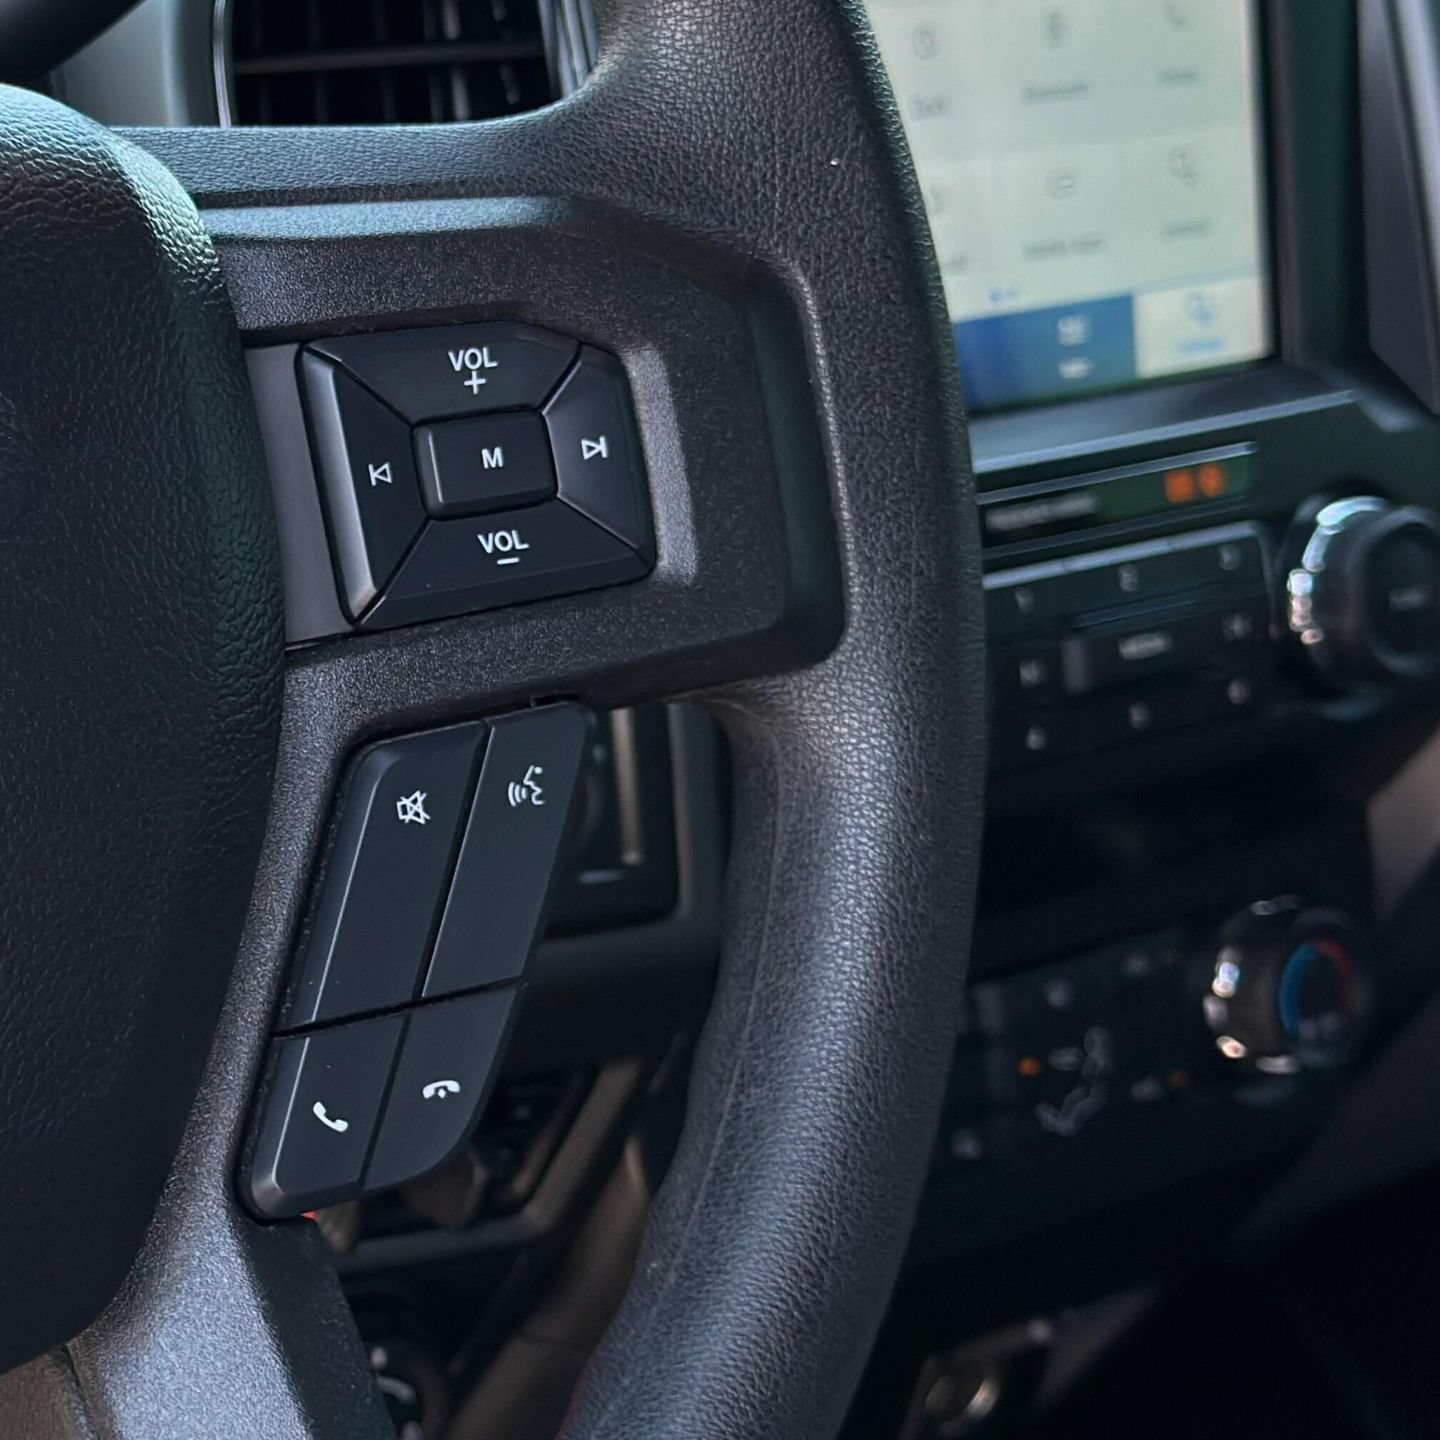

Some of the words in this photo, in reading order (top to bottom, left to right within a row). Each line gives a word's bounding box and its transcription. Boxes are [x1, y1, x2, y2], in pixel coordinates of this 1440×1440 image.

[448, 347, 499, 374] VOL
[481, 447, 505, 470] M
[477, 528, 530, 555] VOL
